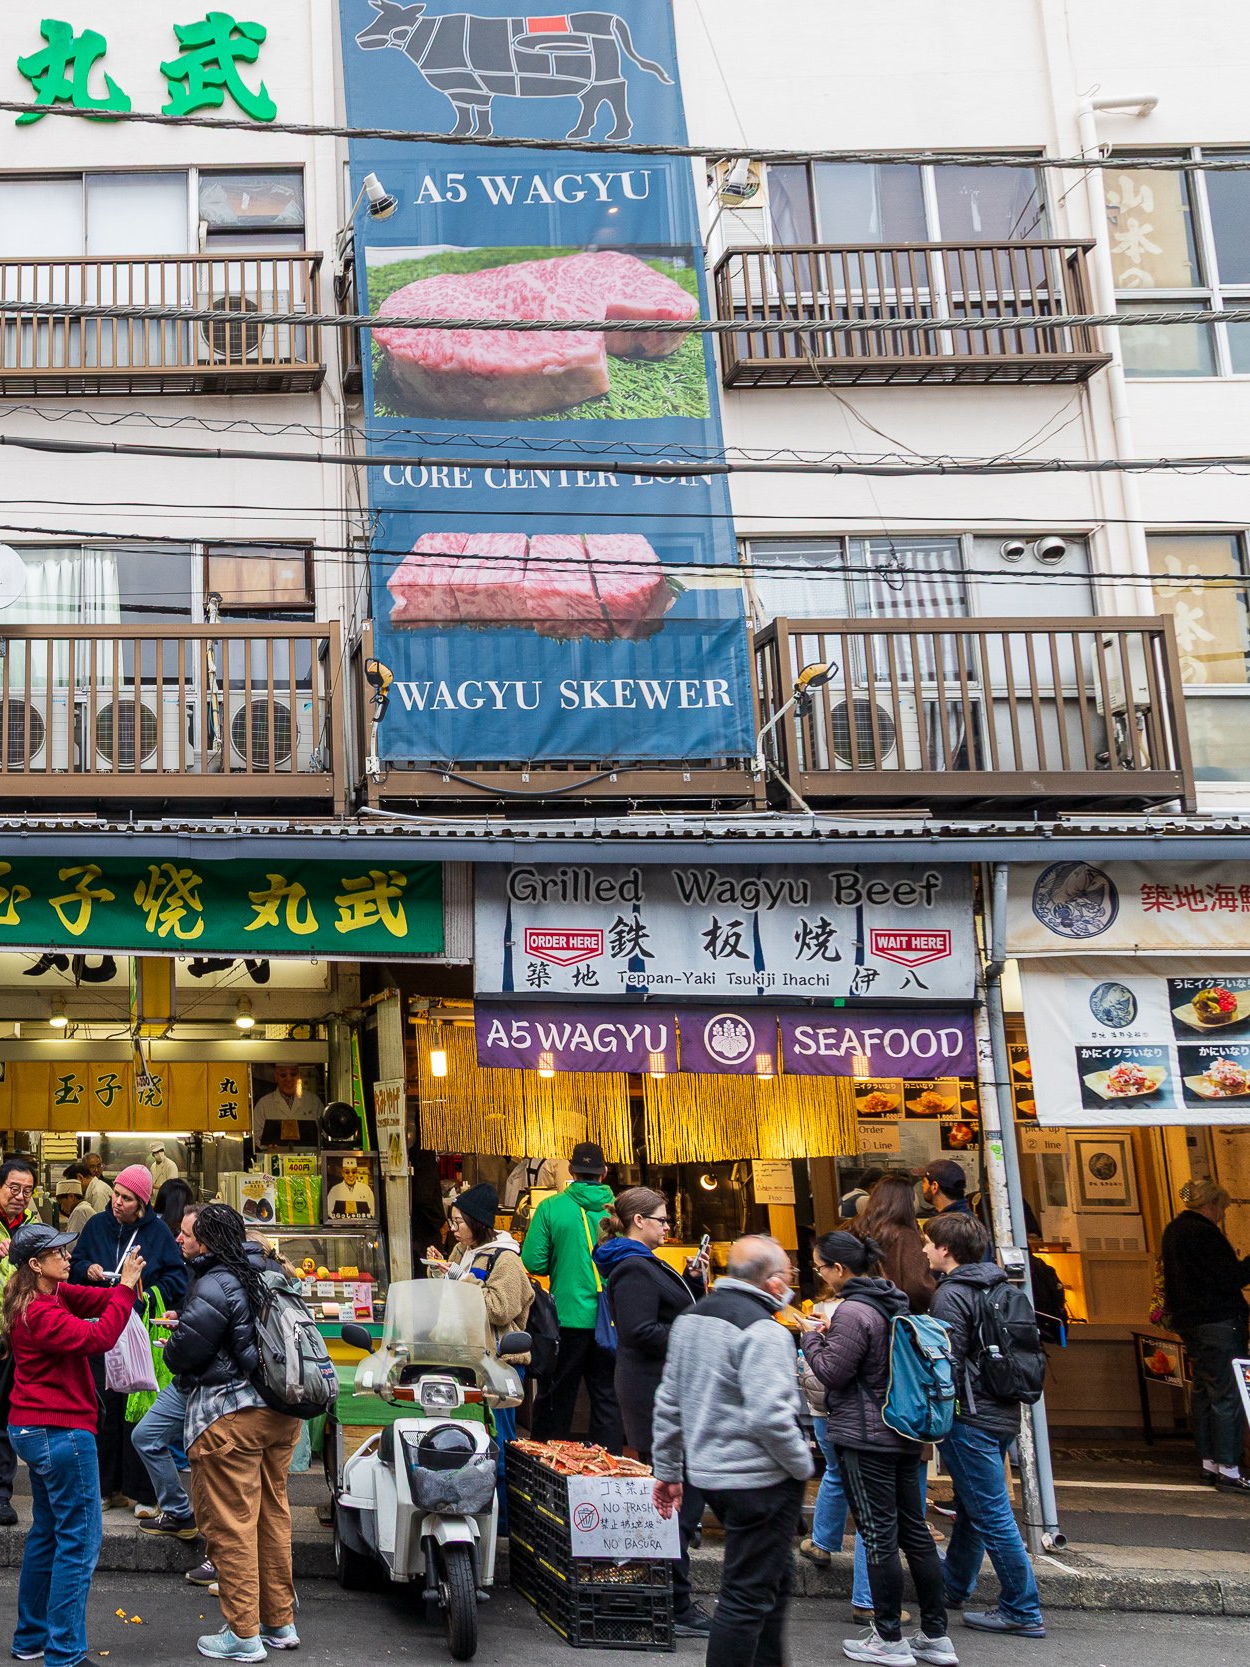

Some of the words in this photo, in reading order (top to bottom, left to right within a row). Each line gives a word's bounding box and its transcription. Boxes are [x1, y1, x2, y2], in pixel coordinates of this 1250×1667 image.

[15, 12, 277, 126] 丸武
[414, 173, 467, 204] A5
[477, 170, 652, 205] WAGYU
[383, 464, 473, 487] CORE
[485, 465, 619, 490] CENTER
[393, 680, 542, 711] WAGYU
[560, 678, 734, 710] SKEWER
[510, 868, 644, 902] Grilled
[674, 871, 809, 910] Wagyu
[832, 873, 940, 906] Beef
[244, 870, 409, 938] 丸武
[530, 935, 567, 948] ORDER
[570, 936, 598, 948] HERE
[608, 915, 842, 962] 鉄板焼
[877, 936, 908, 949] WAIT
[911, 937, 945, 949] HERE
[526, 961, 600, 989] 築地
[618, 971, 716, 985] Teppan-Yaki
[726, 972, 776, 988] Tsukiji
[782, 973, 830, 986] Ihachi
[851, 967, 929, 993] 伊八
[487, 1019, 532, 1049] A5
[535, 1022, 668, 1053] WAGYU
[794, 1025, 964, 1058] SEAFOOD
[1081, 1048, 1162, 1059] かにイクラいなり
[1199, 1047, 1249, 1057] かにいなり
[218, 1078, 239, 1121] 丸武
[859, 1126, 885, 1134] Order
[873, 1141, 893, 1149] Line
[1044, 1141, 1061, 1149] line
[288, 1163, 310, 1172] 400円
[601, 1481, 650, 1497] ゴミ禁止
[603, 1503, 620, 1513] NO
[623, 1502, 654, 1514] TRASH
[603, 1539, 619, 1550] NO
[624, 1537, 663, 1550] BASURA
